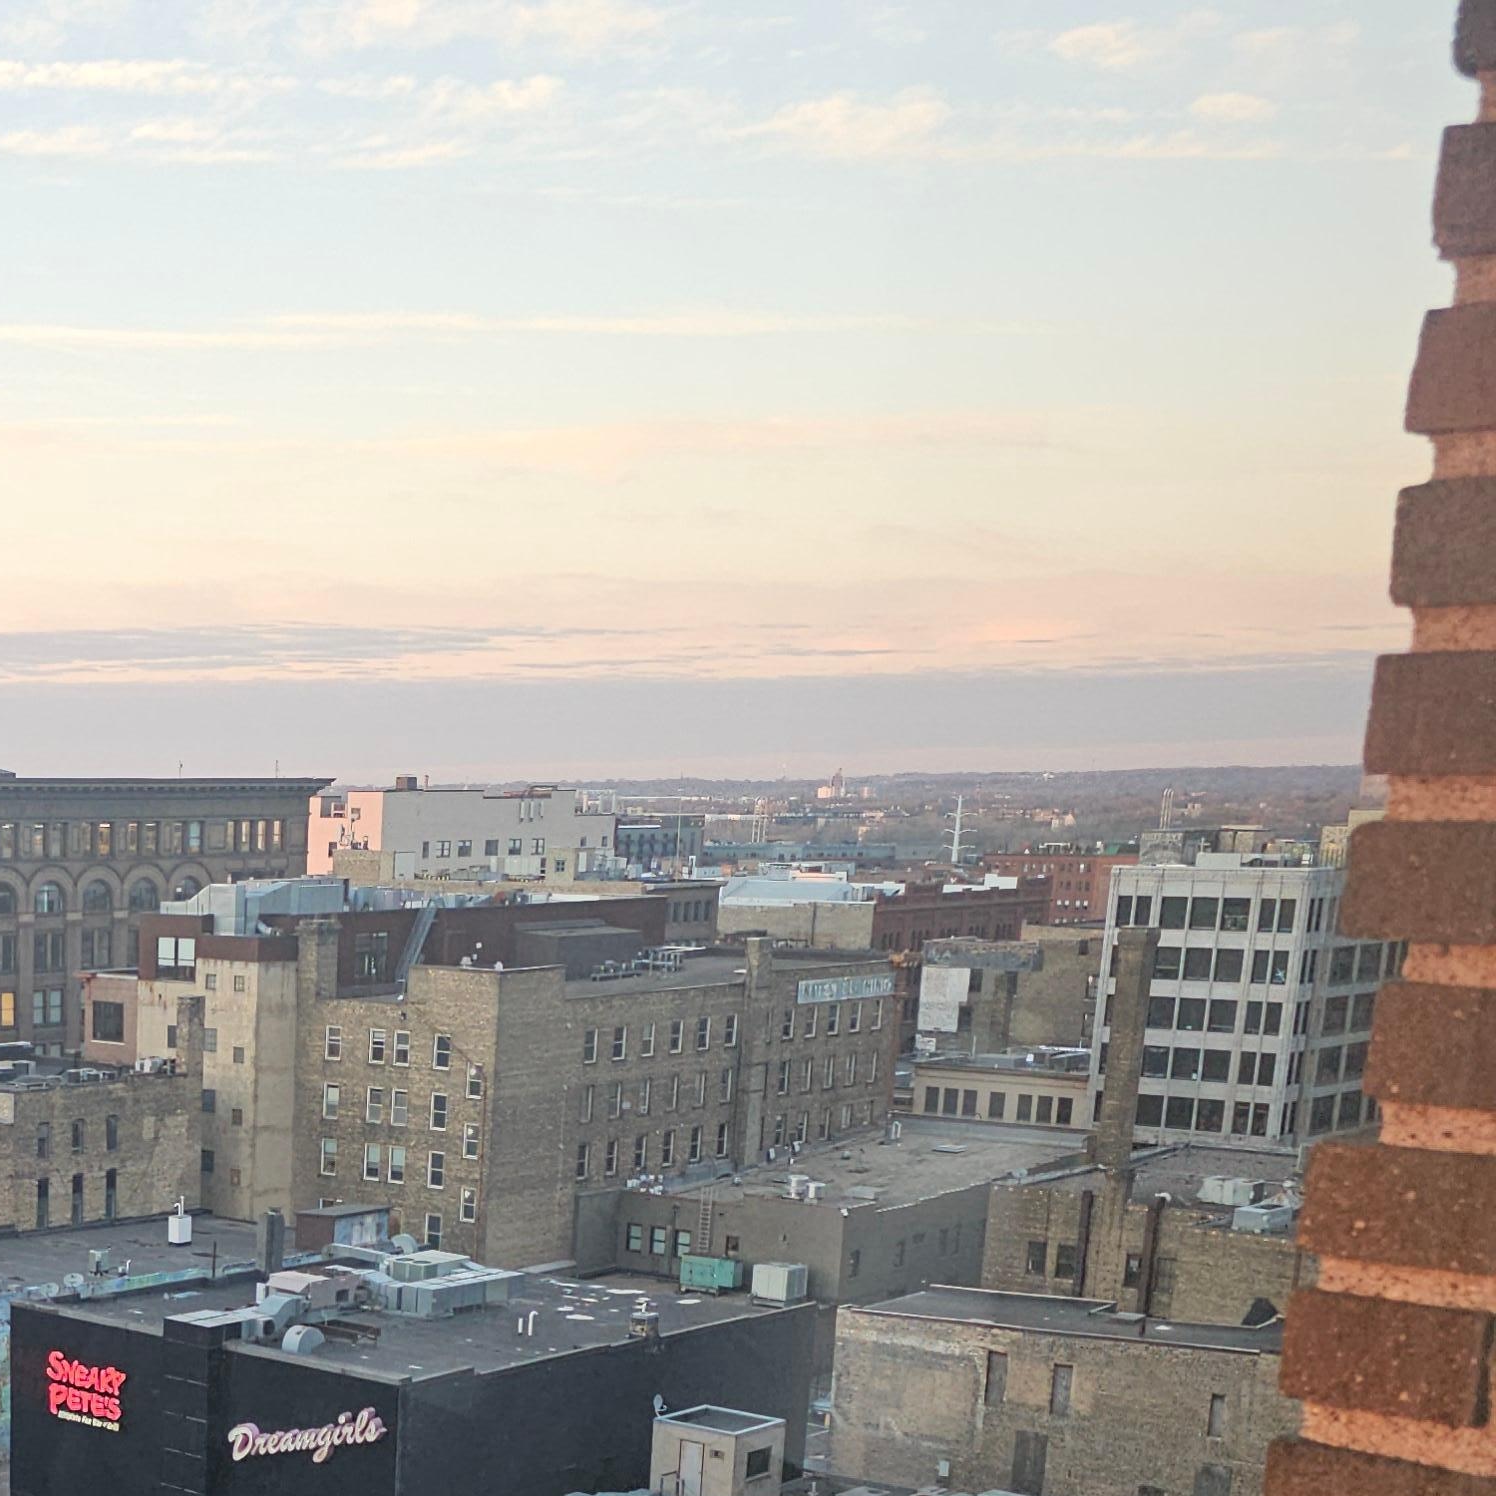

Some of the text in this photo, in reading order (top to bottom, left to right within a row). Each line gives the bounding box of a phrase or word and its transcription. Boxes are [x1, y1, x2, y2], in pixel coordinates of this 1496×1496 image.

[47, 1351, 126, 1396] SNEAKY
[49, 1382, 121, 1421] PETE'S
[228, 1406, 388, 1464] Dreamgirls
